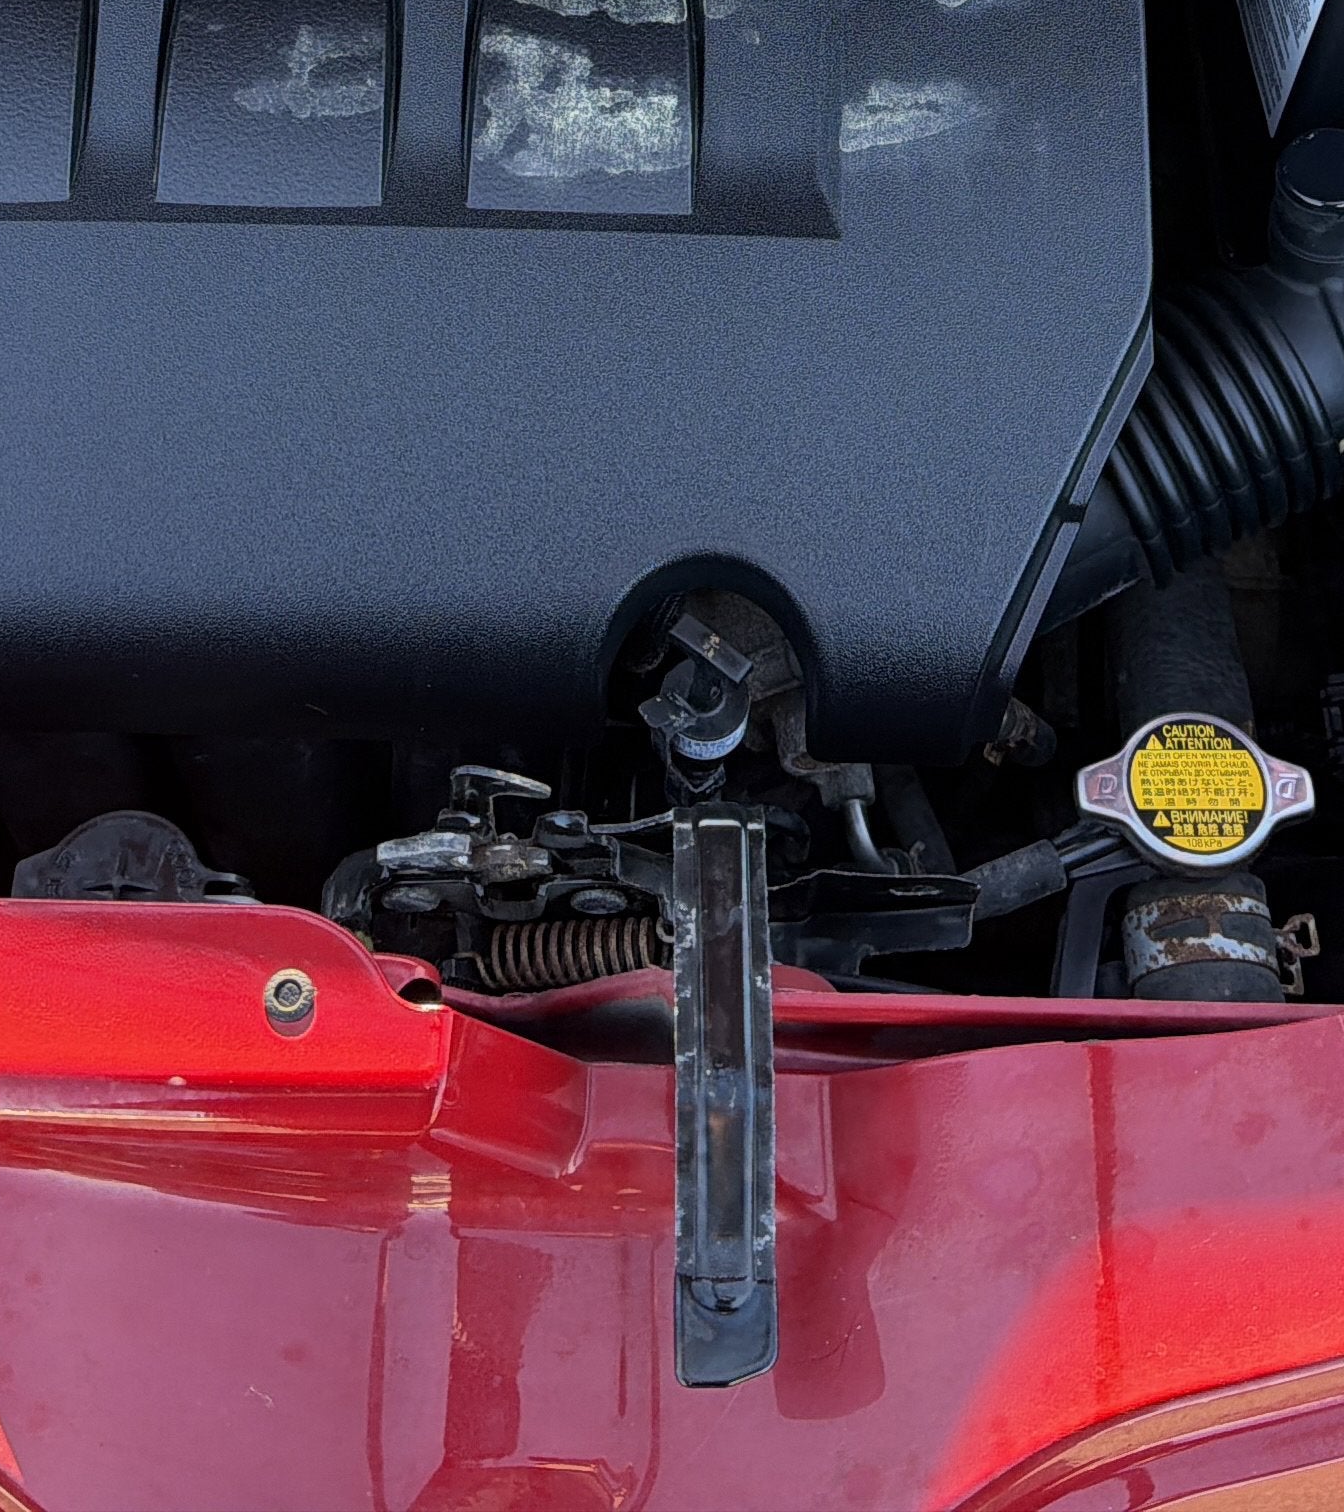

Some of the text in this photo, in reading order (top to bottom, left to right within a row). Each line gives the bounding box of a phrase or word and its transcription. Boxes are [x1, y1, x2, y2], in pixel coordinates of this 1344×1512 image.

[1162, 724, 1215, 738] CAUTION
[1165, 738, 1232, 750] ATTENTION
[1140, 752, 1171, 760] NEVER
[1172, 752, 1198, 760] OPEN
[1200, 752, 1226, 760] WHEN
[1138, 760, 1148, 768] NE
[1150, 760, 1179, 768] JAMAIS
[1180, 760, 1212, 768] OUVRIR
[1170, 810, 1248, 824] ВНИМАНИЕ!
